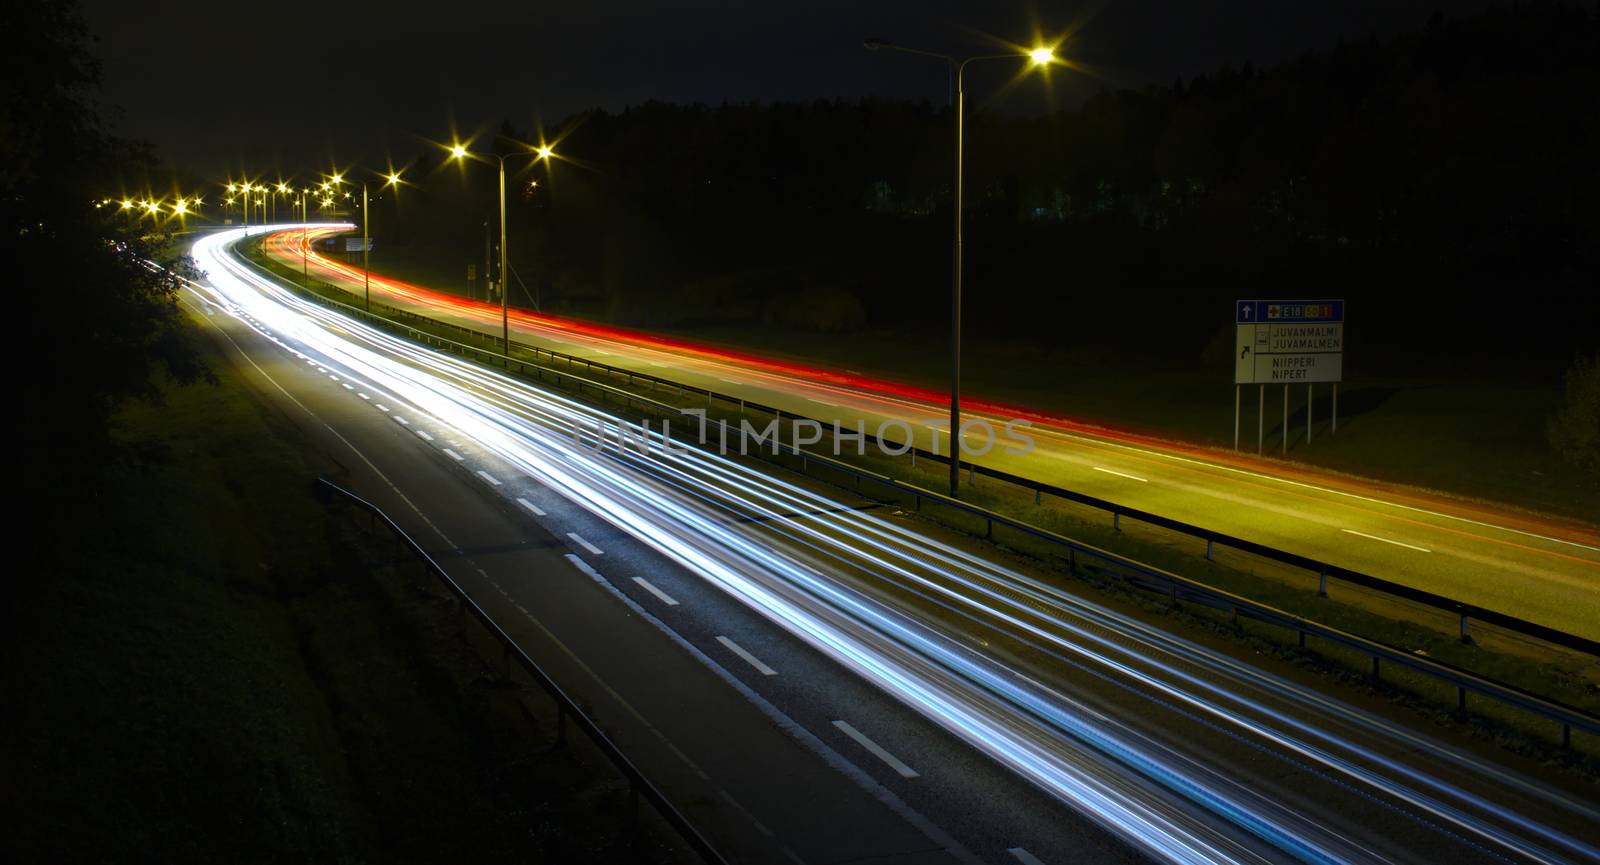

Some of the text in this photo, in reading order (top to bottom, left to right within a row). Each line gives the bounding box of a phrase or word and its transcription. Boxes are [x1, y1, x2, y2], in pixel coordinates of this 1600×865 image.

[1273, 327, 1338, 338] JUVANMALMI
[1273, 338, 1340, 350] JUVAMALMEN
[1272, 358, 1316, 368] NIIPPERI
[1272, 369, 1307, 379] NIPERT
